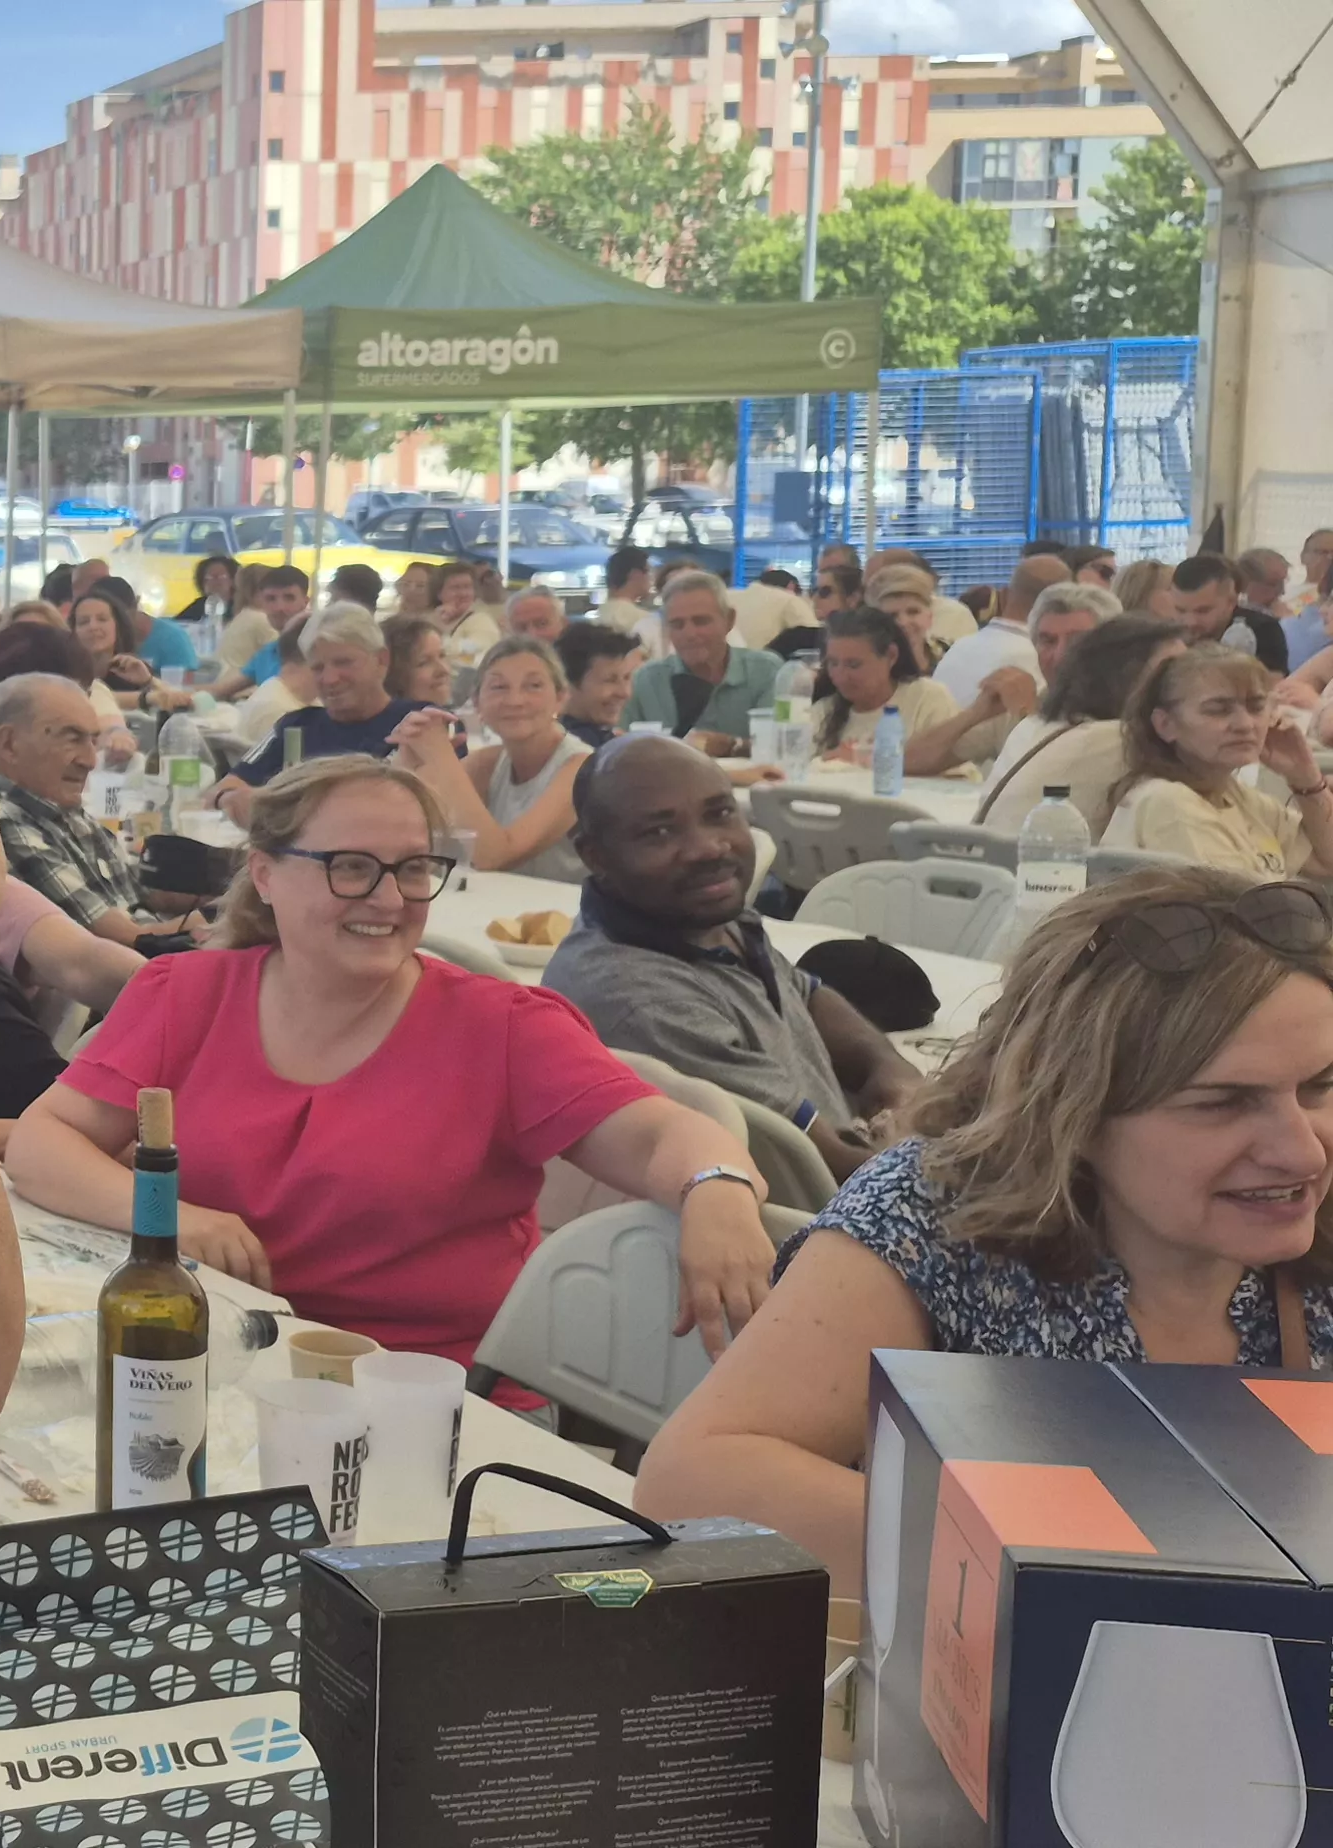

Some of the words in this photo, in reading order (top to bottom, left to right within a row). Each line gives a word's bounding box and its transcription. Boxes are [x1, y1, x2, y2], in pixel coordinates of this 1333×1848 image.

[356, 371, 482, 387] SUPERMERCADOS
[130, 1368, 174, 1381] VIÑAS
[332, 1467, 361, 1502] RO
[24, 1741, 68, 1756] SPORT
[71, 1736, 118, 1751] URBAN
[0, 1736, 229, 1791] Different
